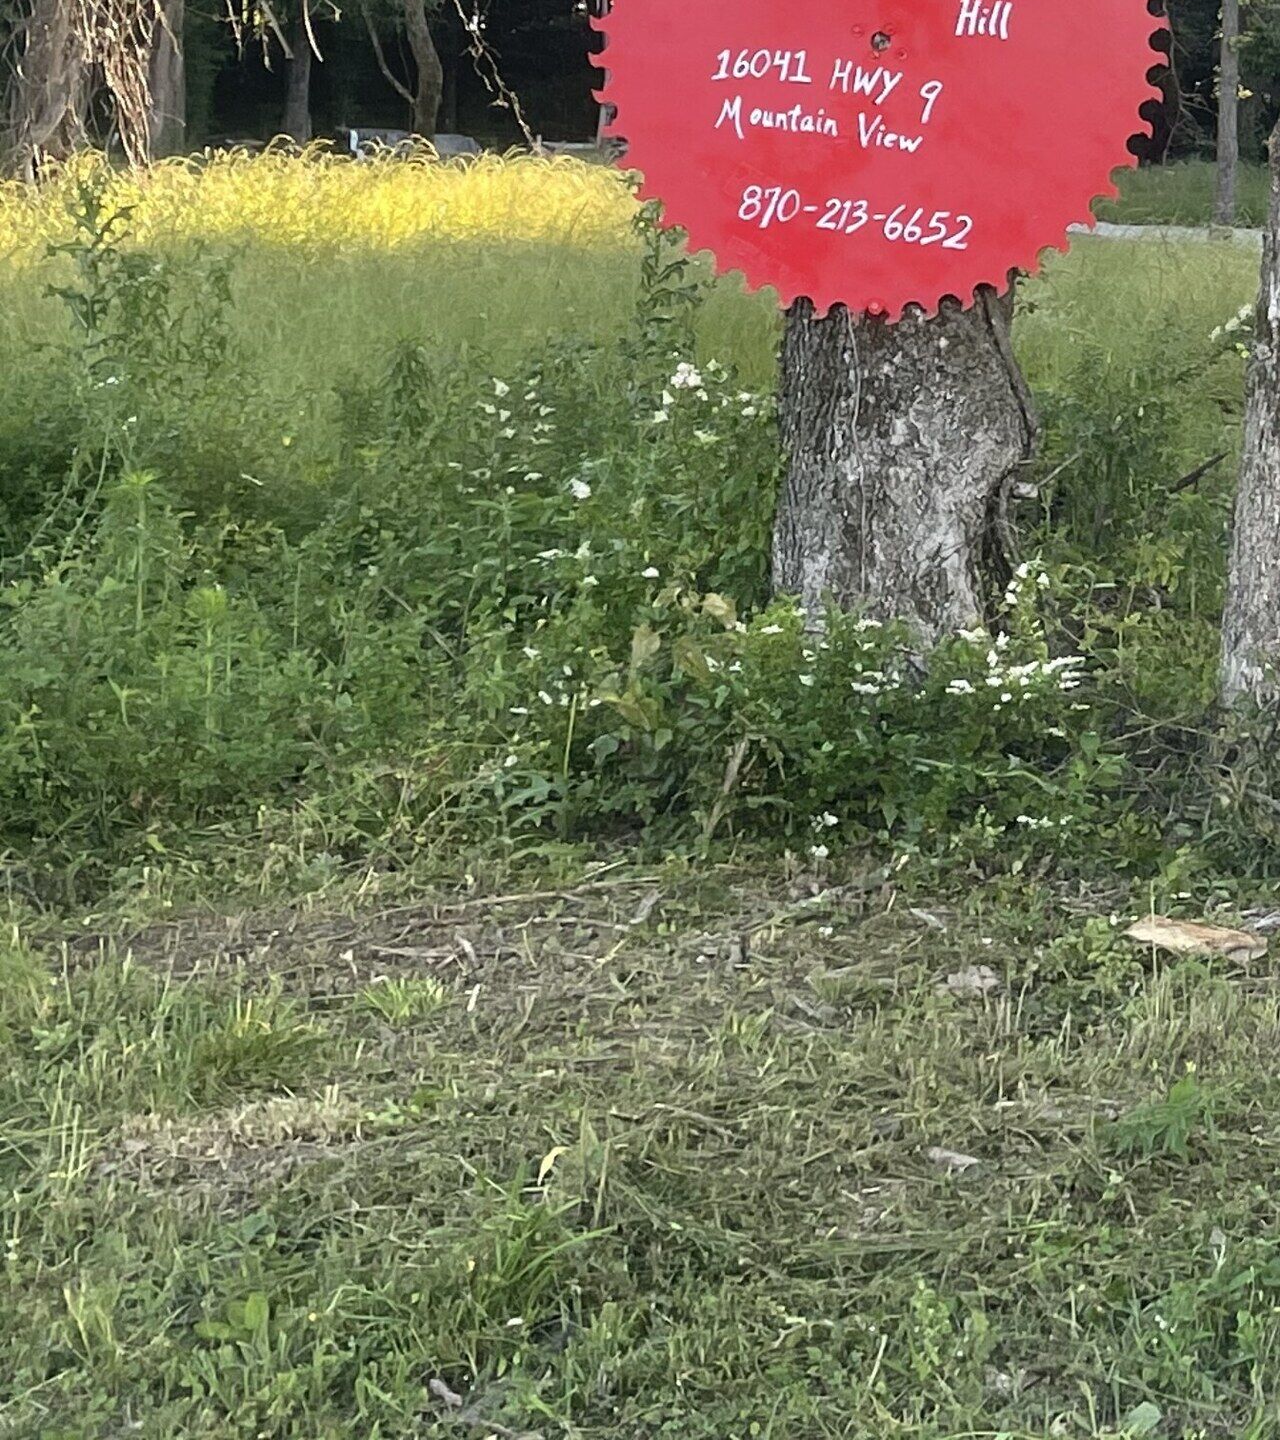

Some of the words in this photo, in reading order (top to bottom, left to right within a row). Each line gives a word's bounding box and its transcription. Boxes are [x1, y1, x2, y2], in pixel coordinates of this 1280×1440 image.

[711, 48, 812, 83] 16041
[829, 58, 903, 105] HWY
[919, 80, 943, 124] 9
[714, 95, 838, 139] Mountain
[858, 112, 924, 153] View
[738, 185, 973, 250] 870-213-6652
